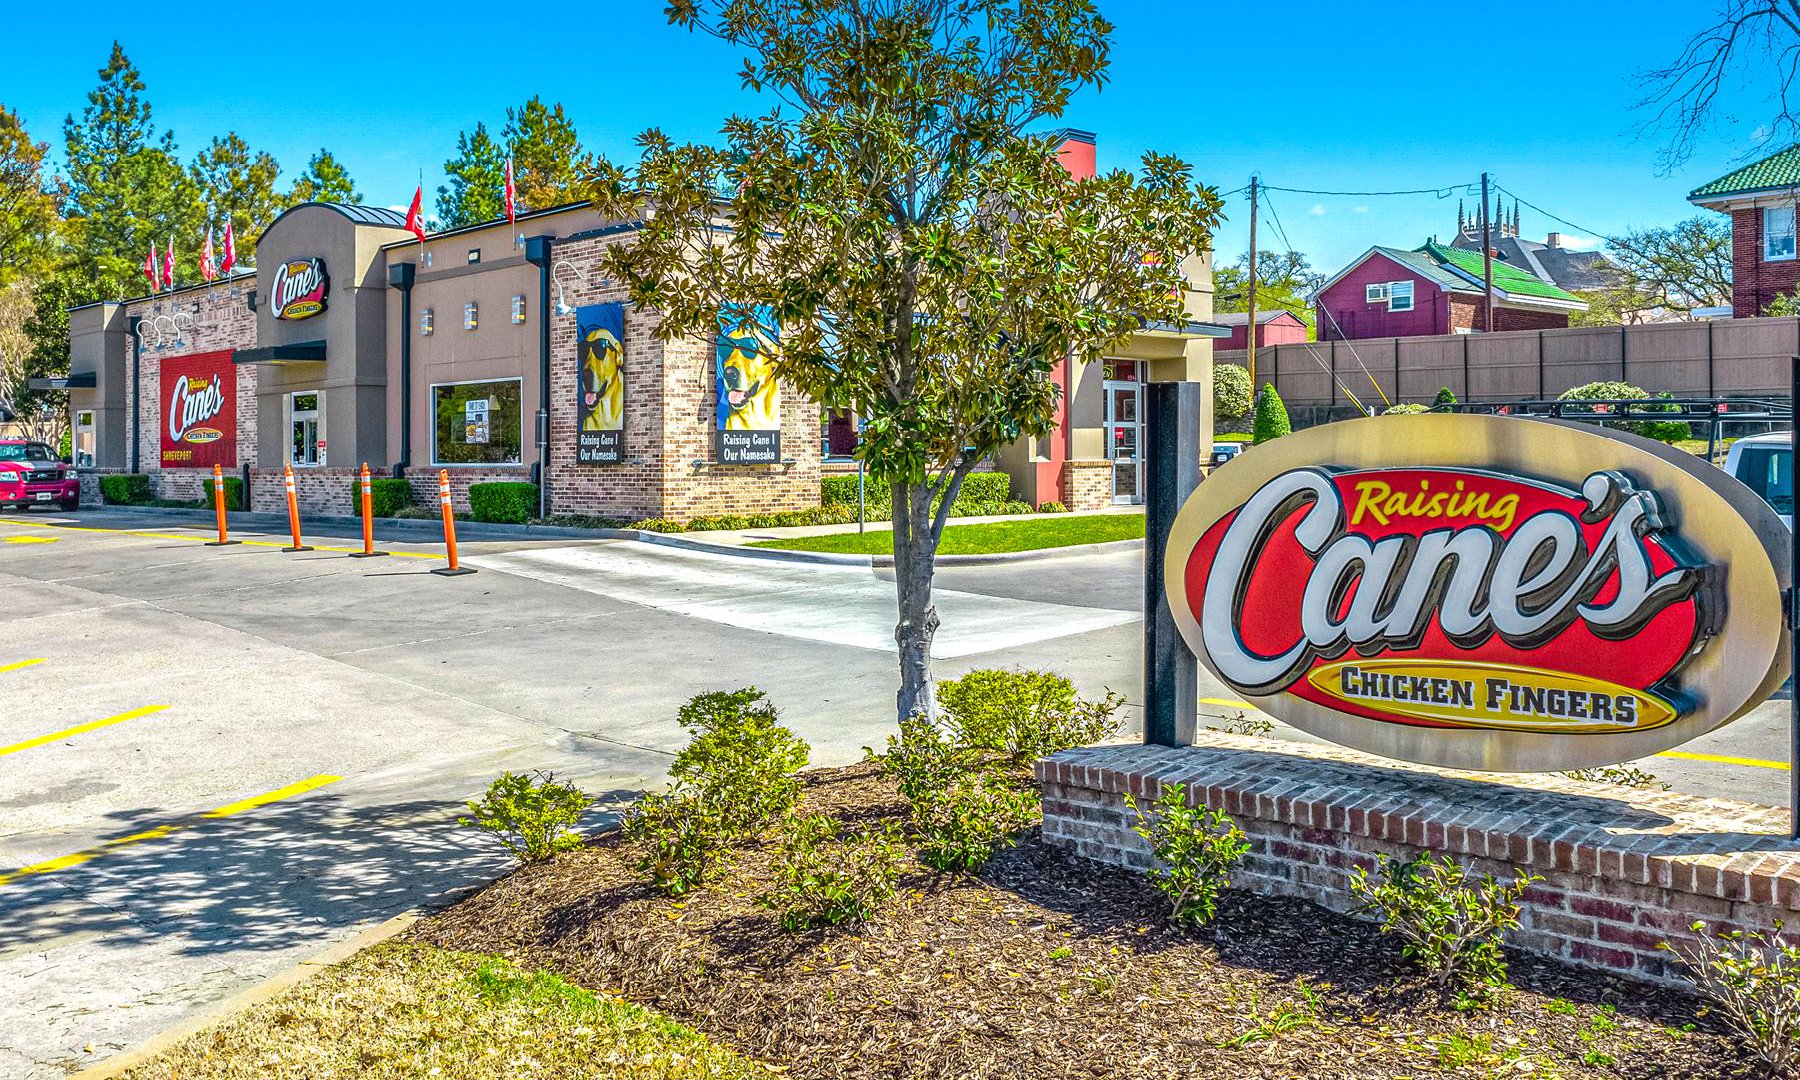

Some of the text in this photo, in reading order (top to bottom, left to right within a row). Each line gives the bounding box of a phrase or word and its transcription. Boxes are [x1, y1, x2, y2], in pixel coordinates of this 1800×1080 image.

[271, 257, 323, 318] Cane's
[169, 373, 225, 442] Cane's
[580, 434, 600, 449] Raising
[580, 448, 618, 460] Our Namesake
[723, 433, 751, 448] Raising
[752, 433, 770, 445] Cane
[724, 447, 776, 461] Our Namesake
[1351, 479, 1520, 532] Raising
[1202, 470, 1692, 688] Cane's
[1340, 666, 1638, 727] CHICKEN FINGERS
